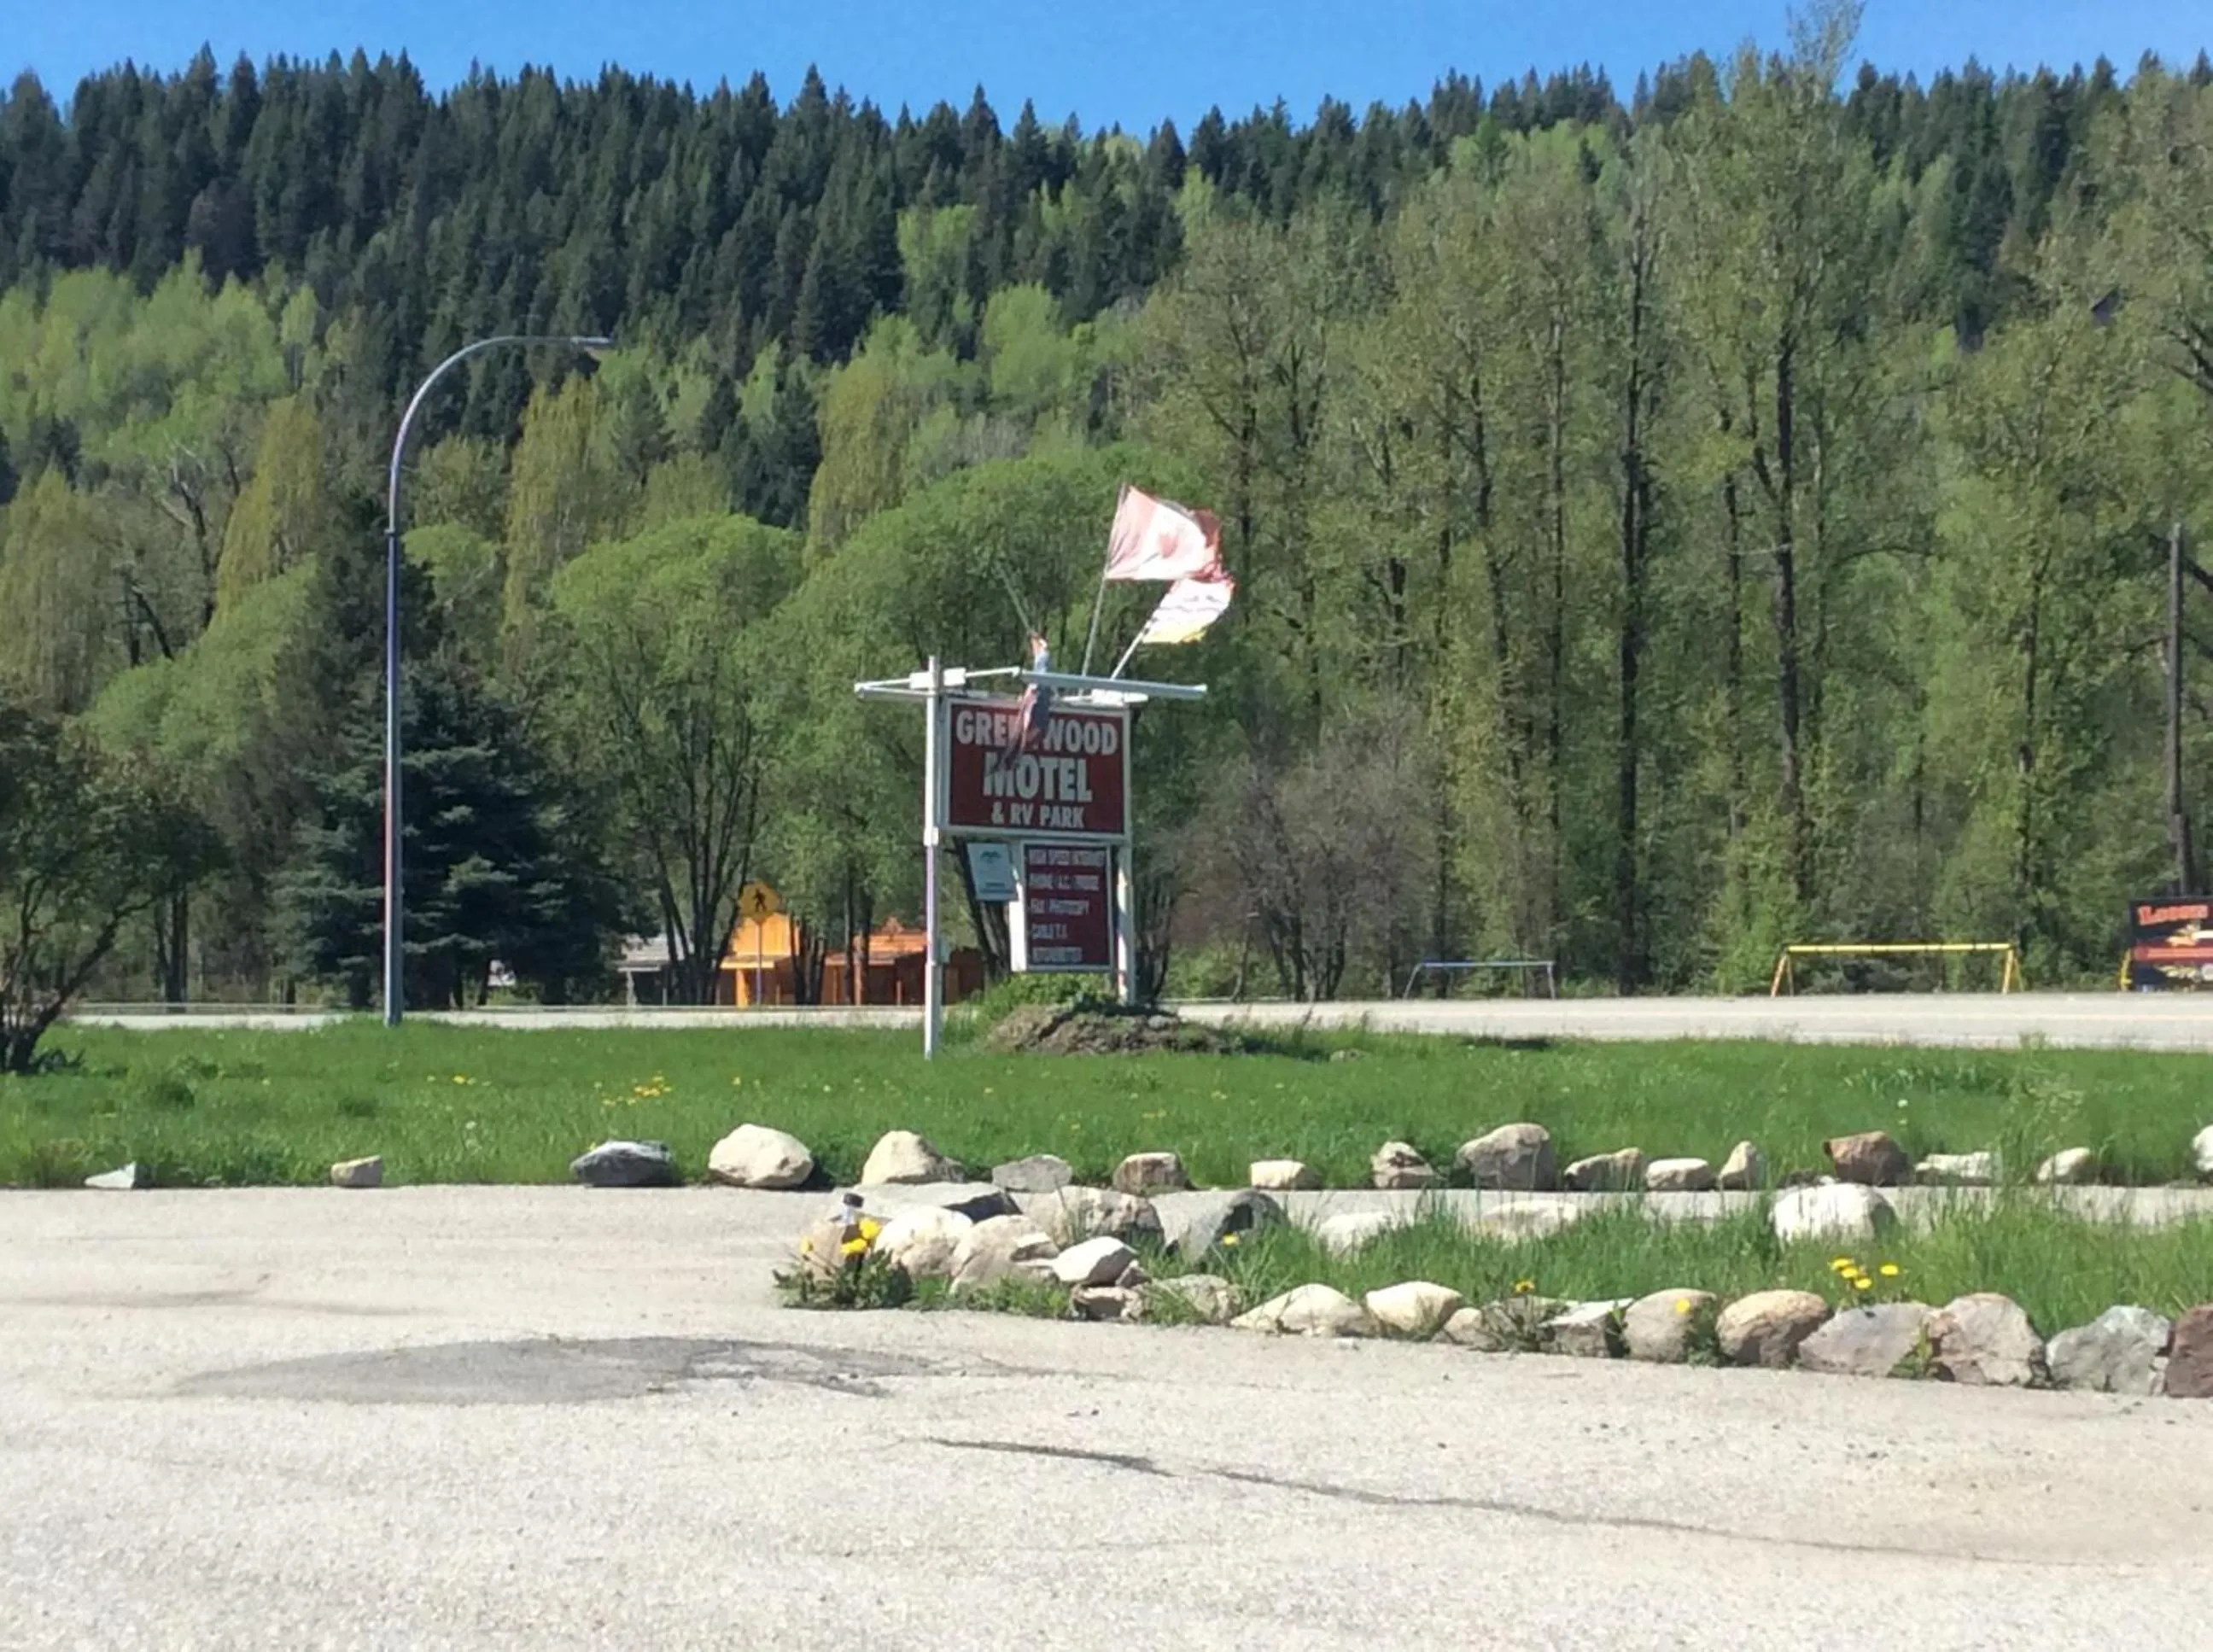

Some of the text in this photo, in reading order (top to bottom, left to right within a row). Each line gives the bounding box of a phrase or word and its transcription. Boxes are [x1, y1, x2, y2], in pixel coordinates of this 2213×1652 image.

[956, 709, 1118, 756] GREWOOD
[983, 752, 1093, 803] MOTEL
[991, 801, 1084, 829] & RV PARK
